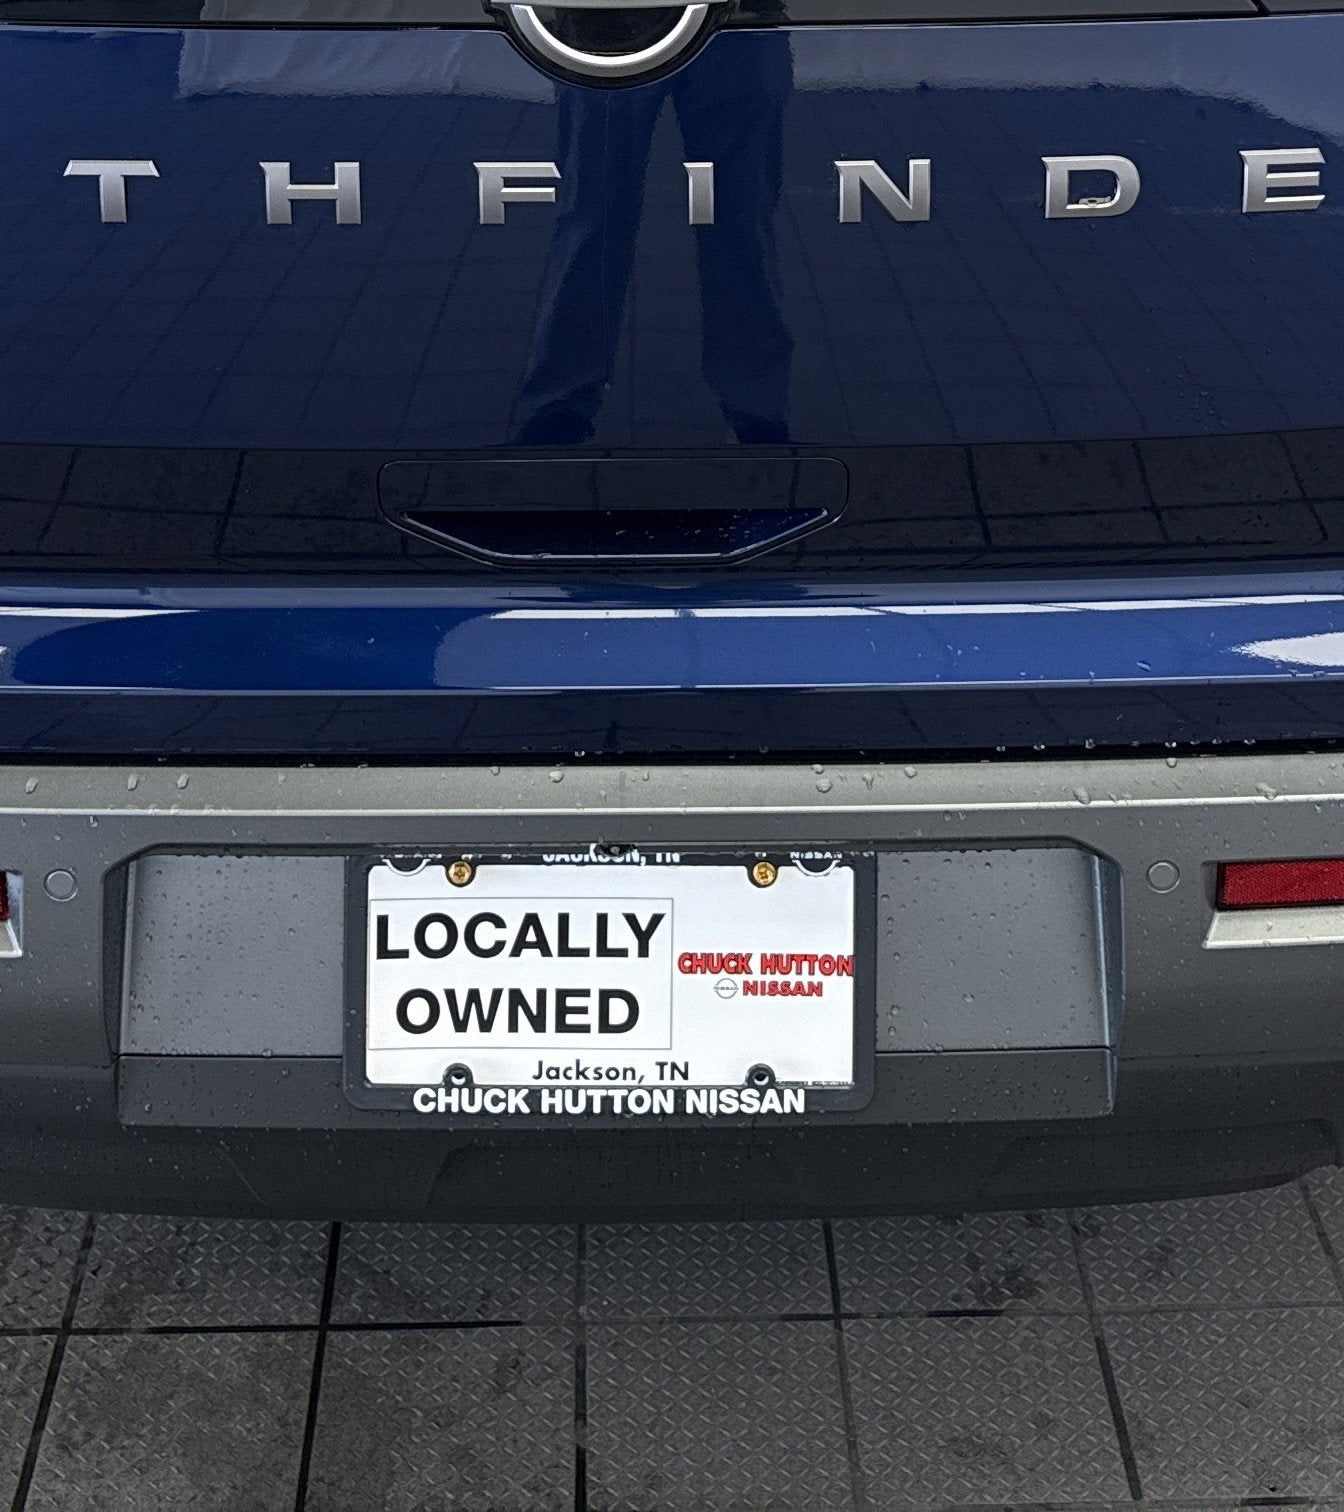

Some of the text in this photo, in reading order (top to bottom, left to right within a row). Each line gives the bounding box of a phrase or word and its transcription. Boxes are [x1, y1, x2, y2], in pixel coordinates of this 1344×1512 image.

[375, 911, 667, 960] LOCALLY
[677, 952, 854, 977] CHUCK HUTTON
[742, 980, 824, 997] NISSAN
[395, 987, 641, 1035] OWNED
[531, 1058, 690, 1085] Jackson, TN
[412, 1088, 806, 1115] CHUCK HUTTON NISSAN
